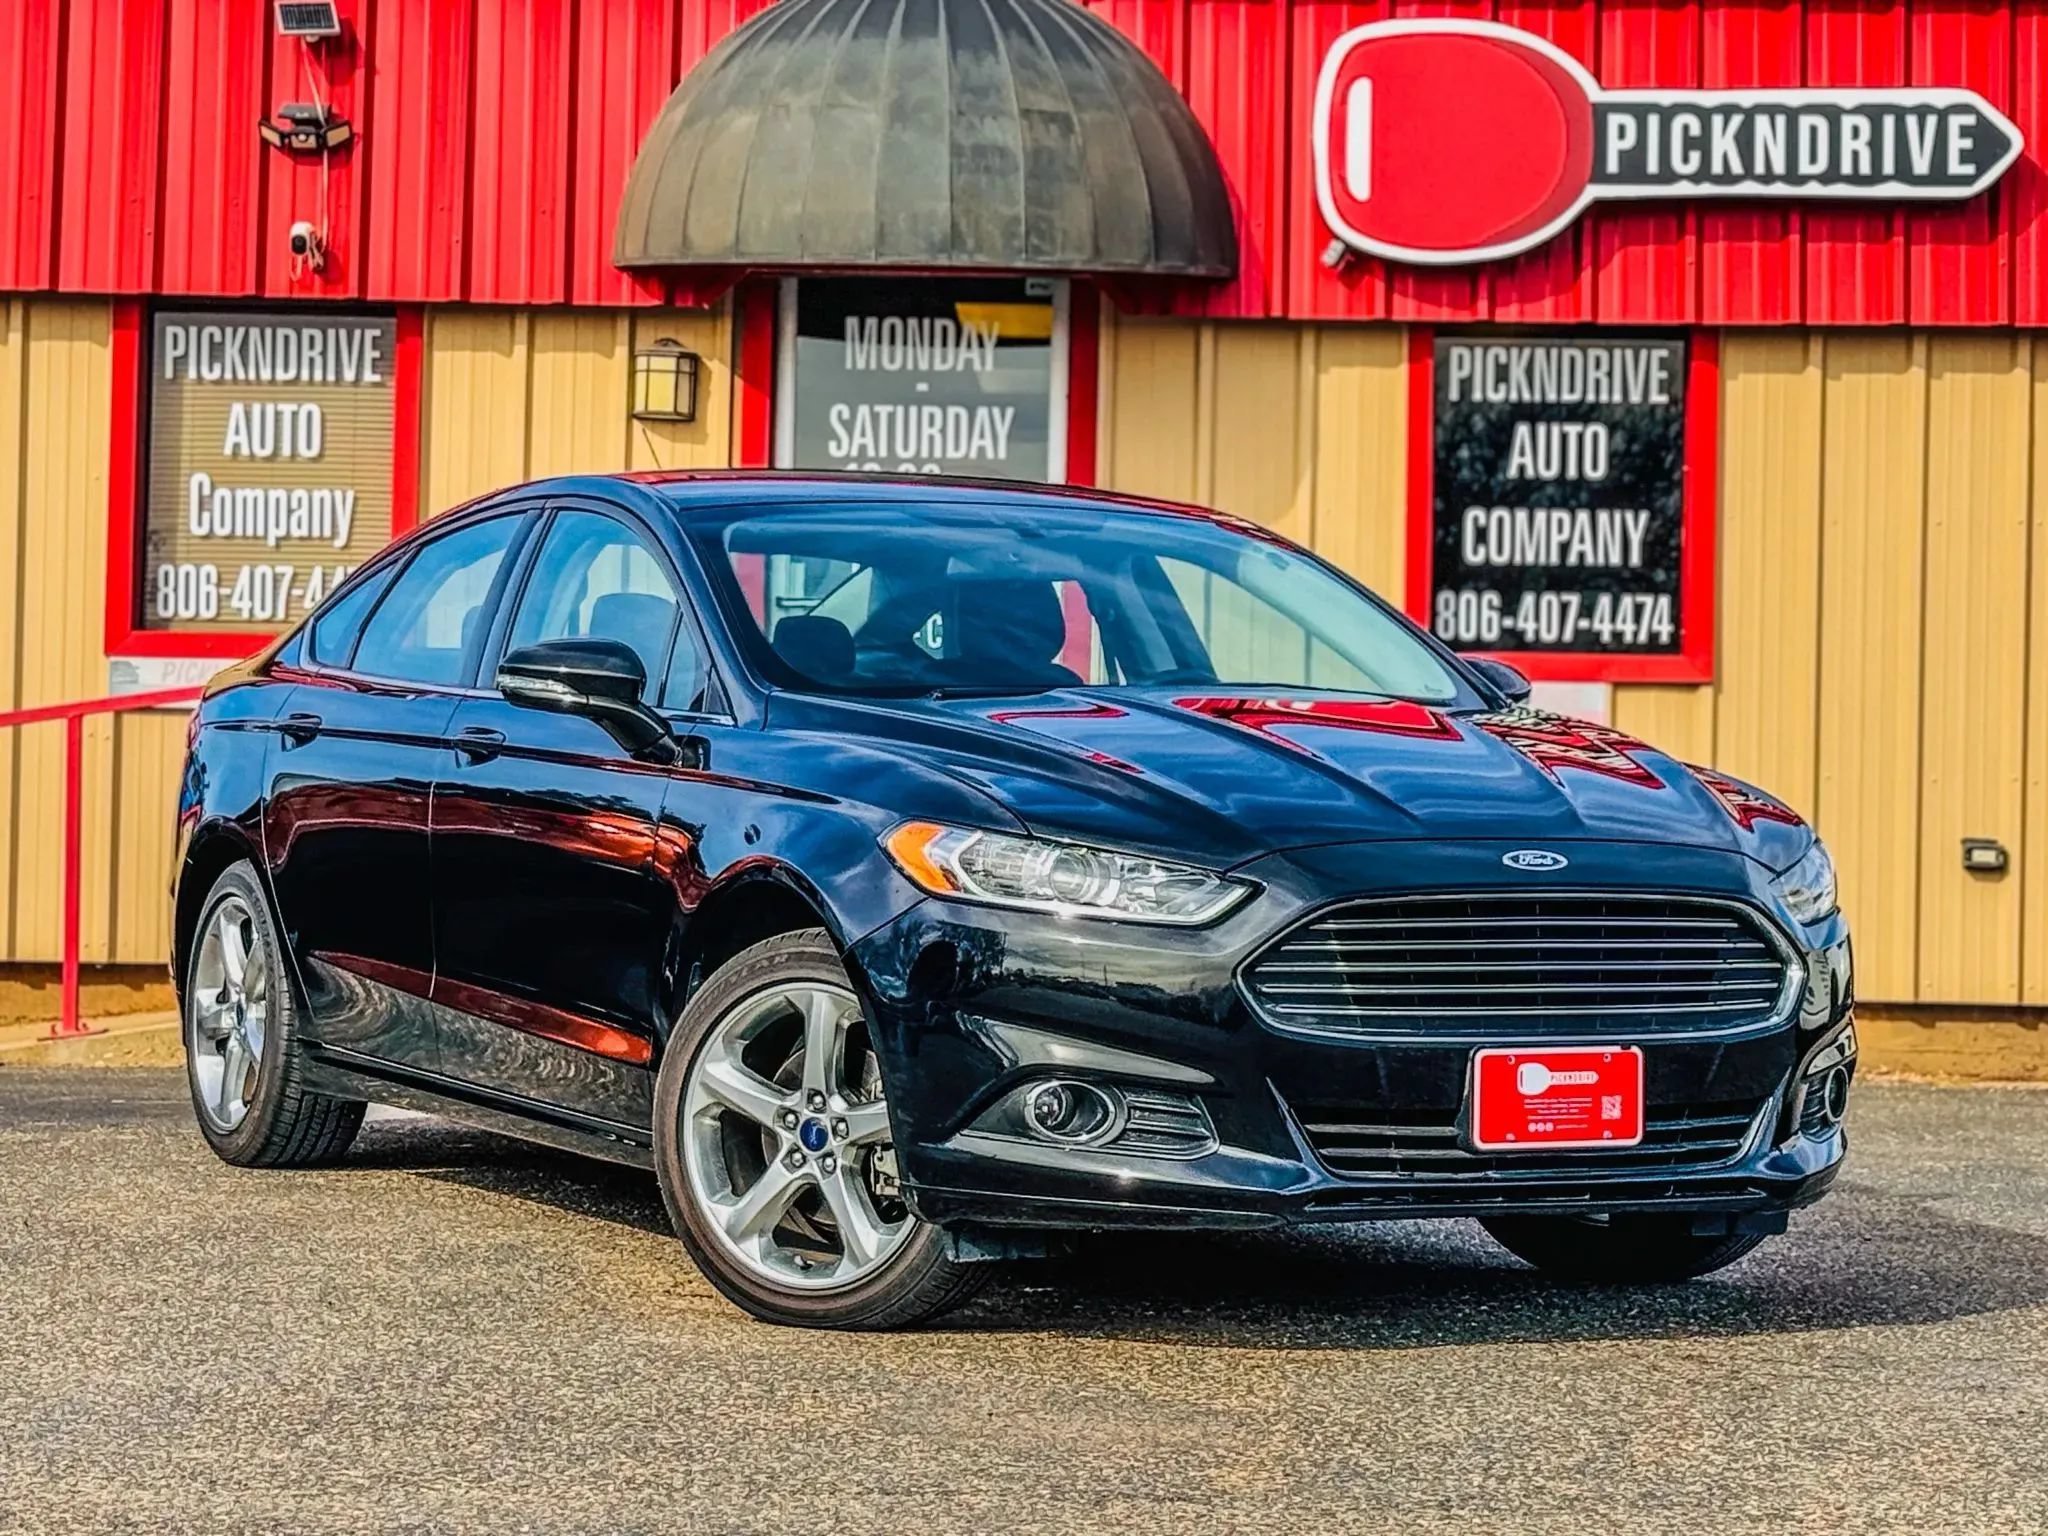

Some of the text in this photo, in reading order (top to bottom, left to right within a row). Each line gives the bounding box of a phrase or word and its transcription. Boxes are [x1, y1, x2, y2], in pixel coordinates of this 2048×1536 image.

[1605, 112, 1978, 176] PICKNDRIVE
[164, 325, 382, 384] PICKNDRIVE
[845, 315, 1001, 373] MONDAY
[1448, 345, 1671, 406] PICKNDRIVE
[223, 401, 322, 459] AUTO
[828, 403, 1014, 461] SATURDAY
[1506, 421, 1609, 482] AUTO
[188, 472, 356, 549] Company
[1462, 506, 1651, 568] COMPANY
[157, 564, 357, 622] 806-407-4
[1435, 589, 1674, 646] 806-407-4474
